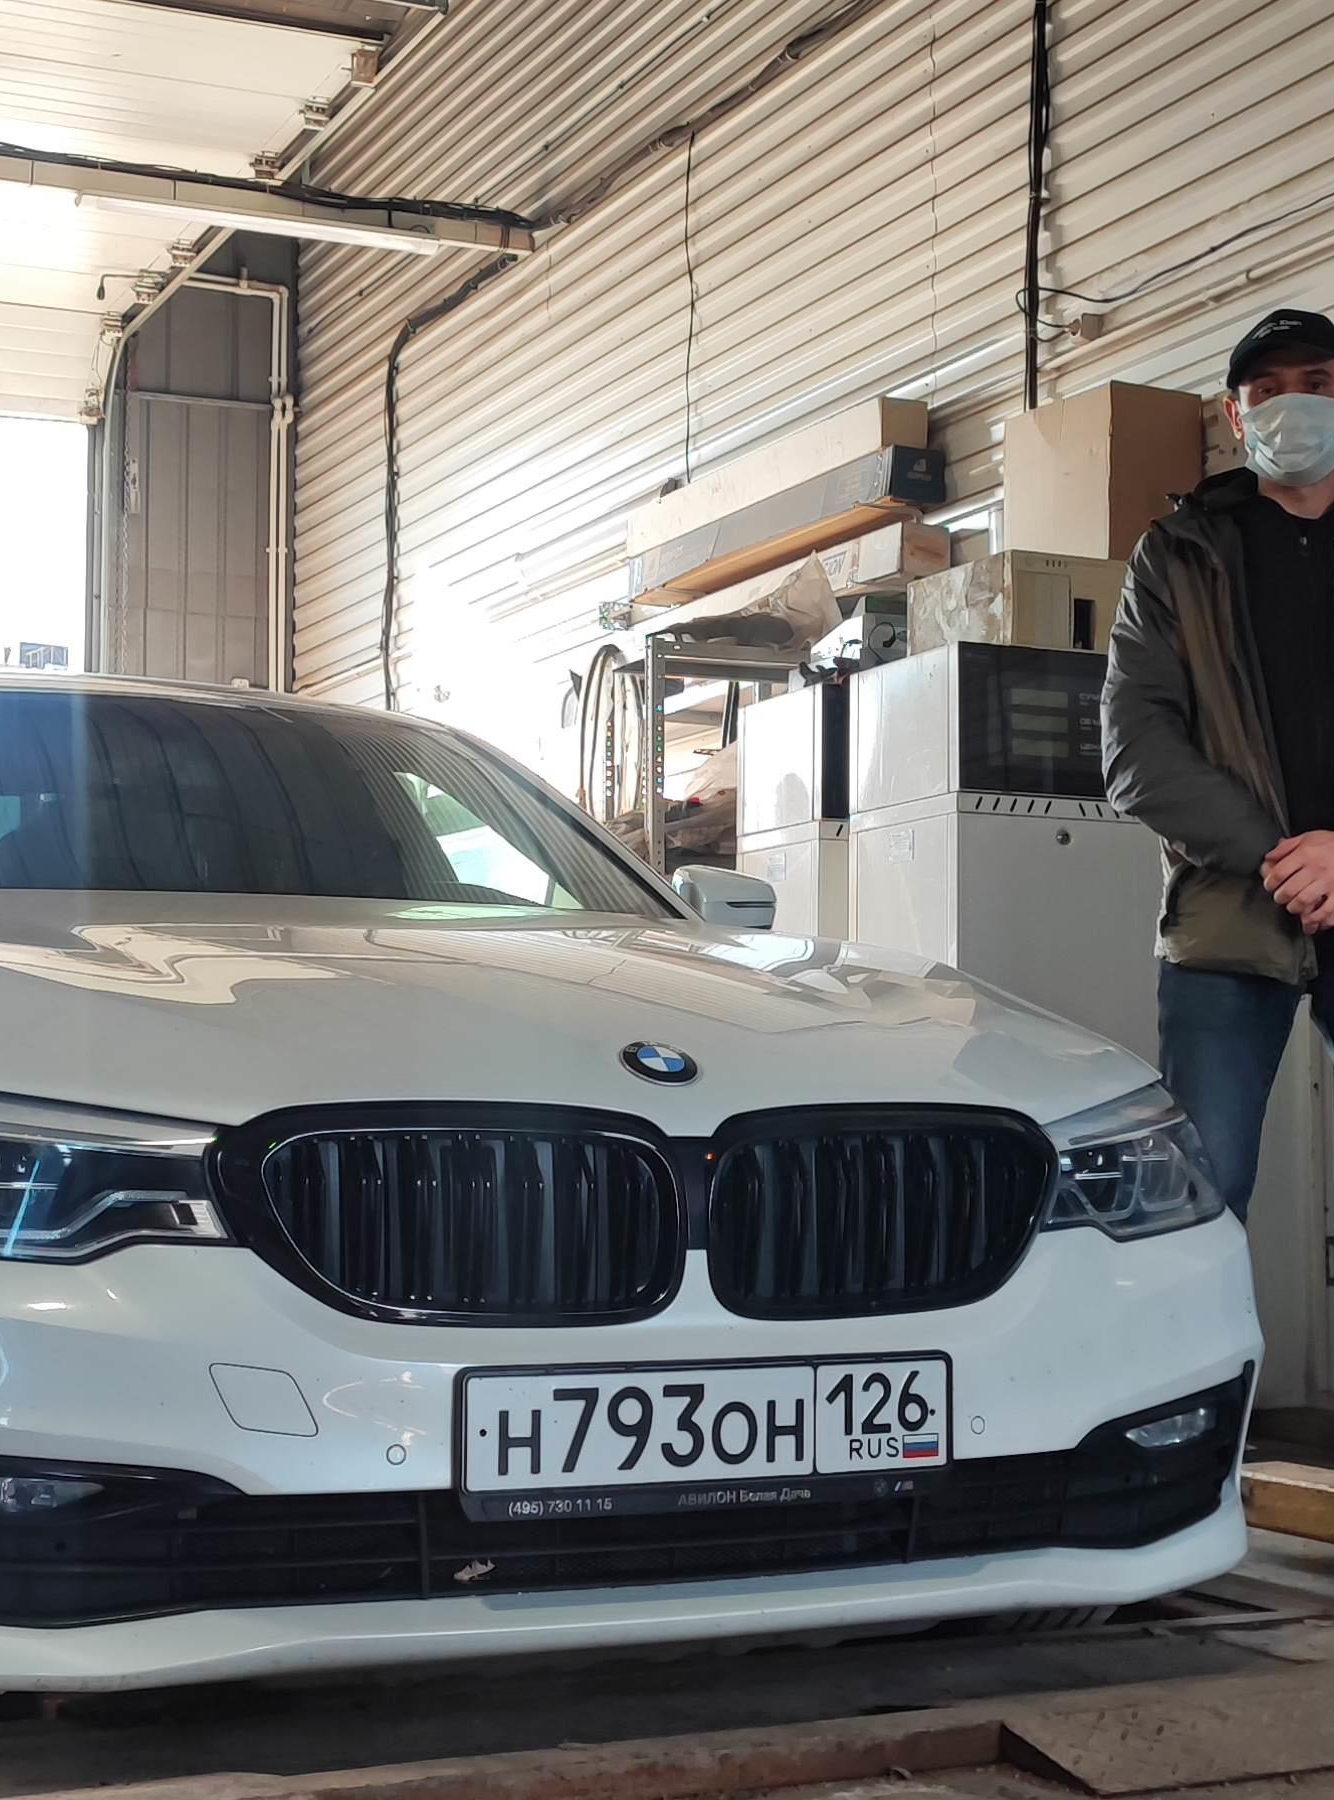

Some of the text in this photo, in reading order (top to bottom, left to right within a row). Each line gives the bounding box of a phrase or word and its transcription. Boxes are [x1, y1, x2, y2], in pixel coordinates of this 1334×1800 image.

[497, 1370, 929, 1476] H793OH 126
[849, 1437, 899, 1459] RUS
[508, 1498, 613, 1517] (495) 730 11 15
